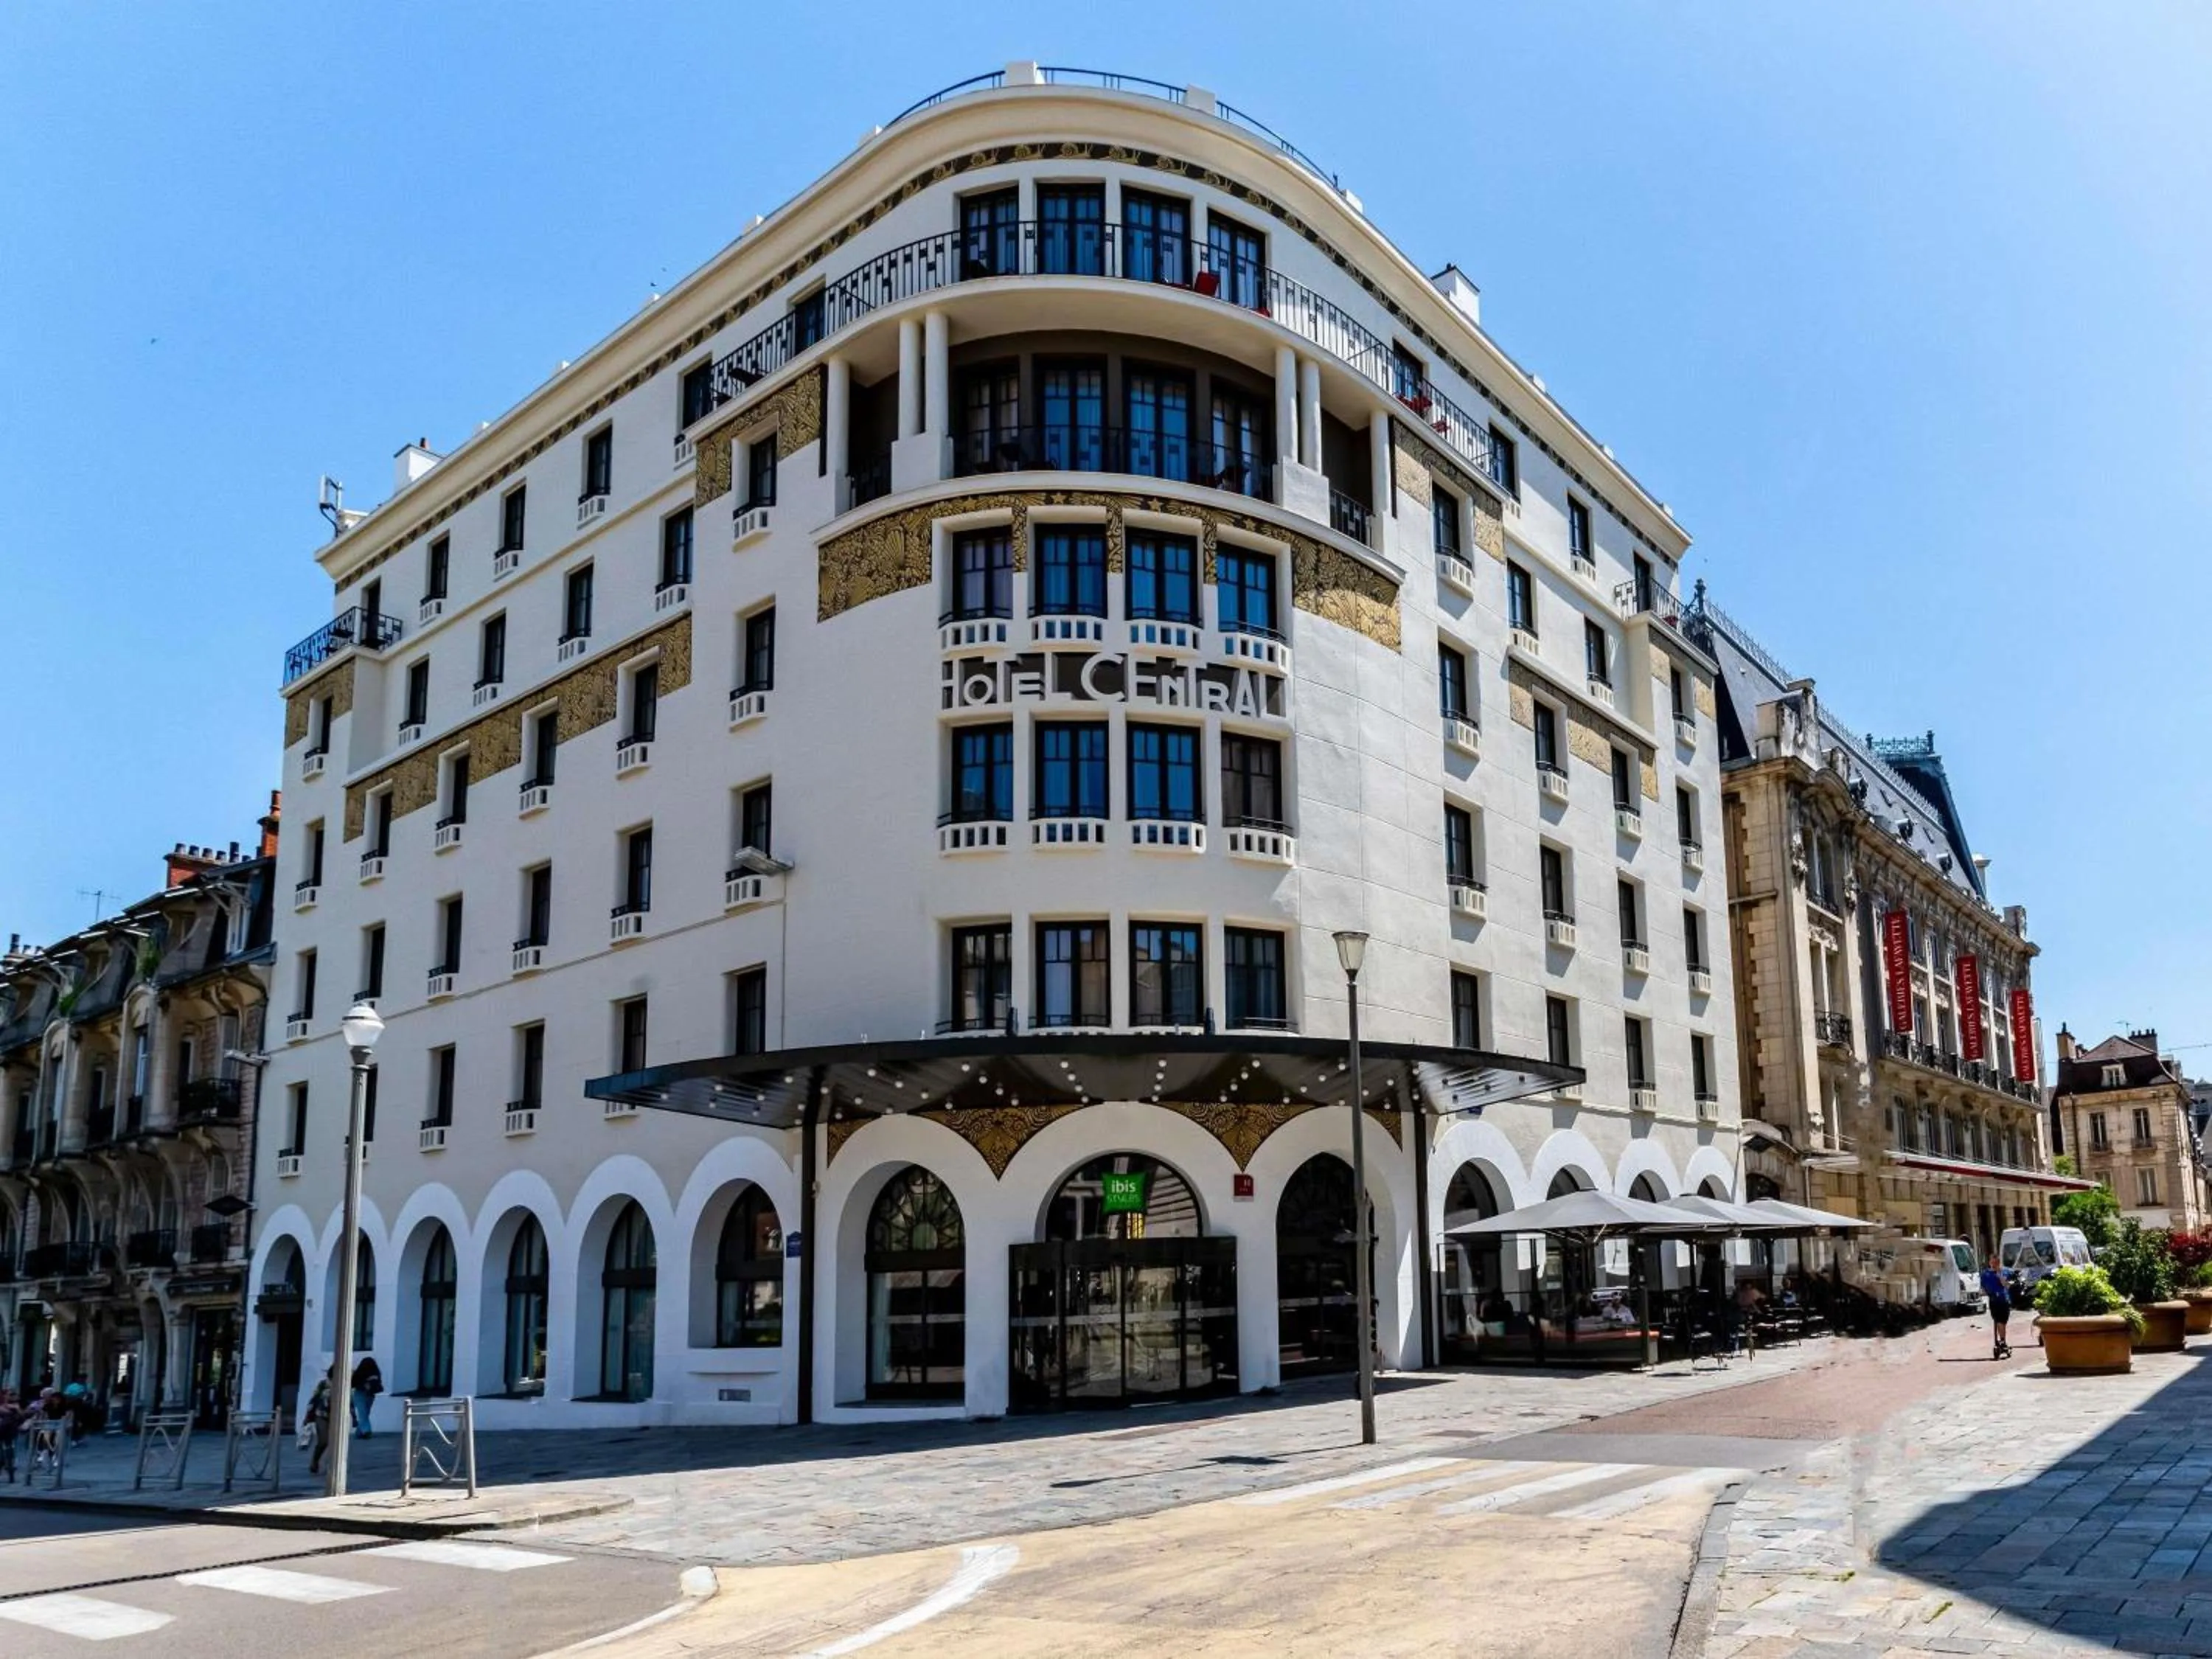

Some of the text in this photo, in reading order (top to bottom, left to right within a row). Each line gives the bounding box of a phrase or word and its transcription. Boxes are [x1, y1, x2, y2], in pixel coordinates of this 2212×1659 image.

[939, 652, 1288, 720] HOTEL CENTRAL
[1891, 917, 1907, 1030] GALERIES LAFAYETTE
[1111, 1179, 1136, 1193] ibis
